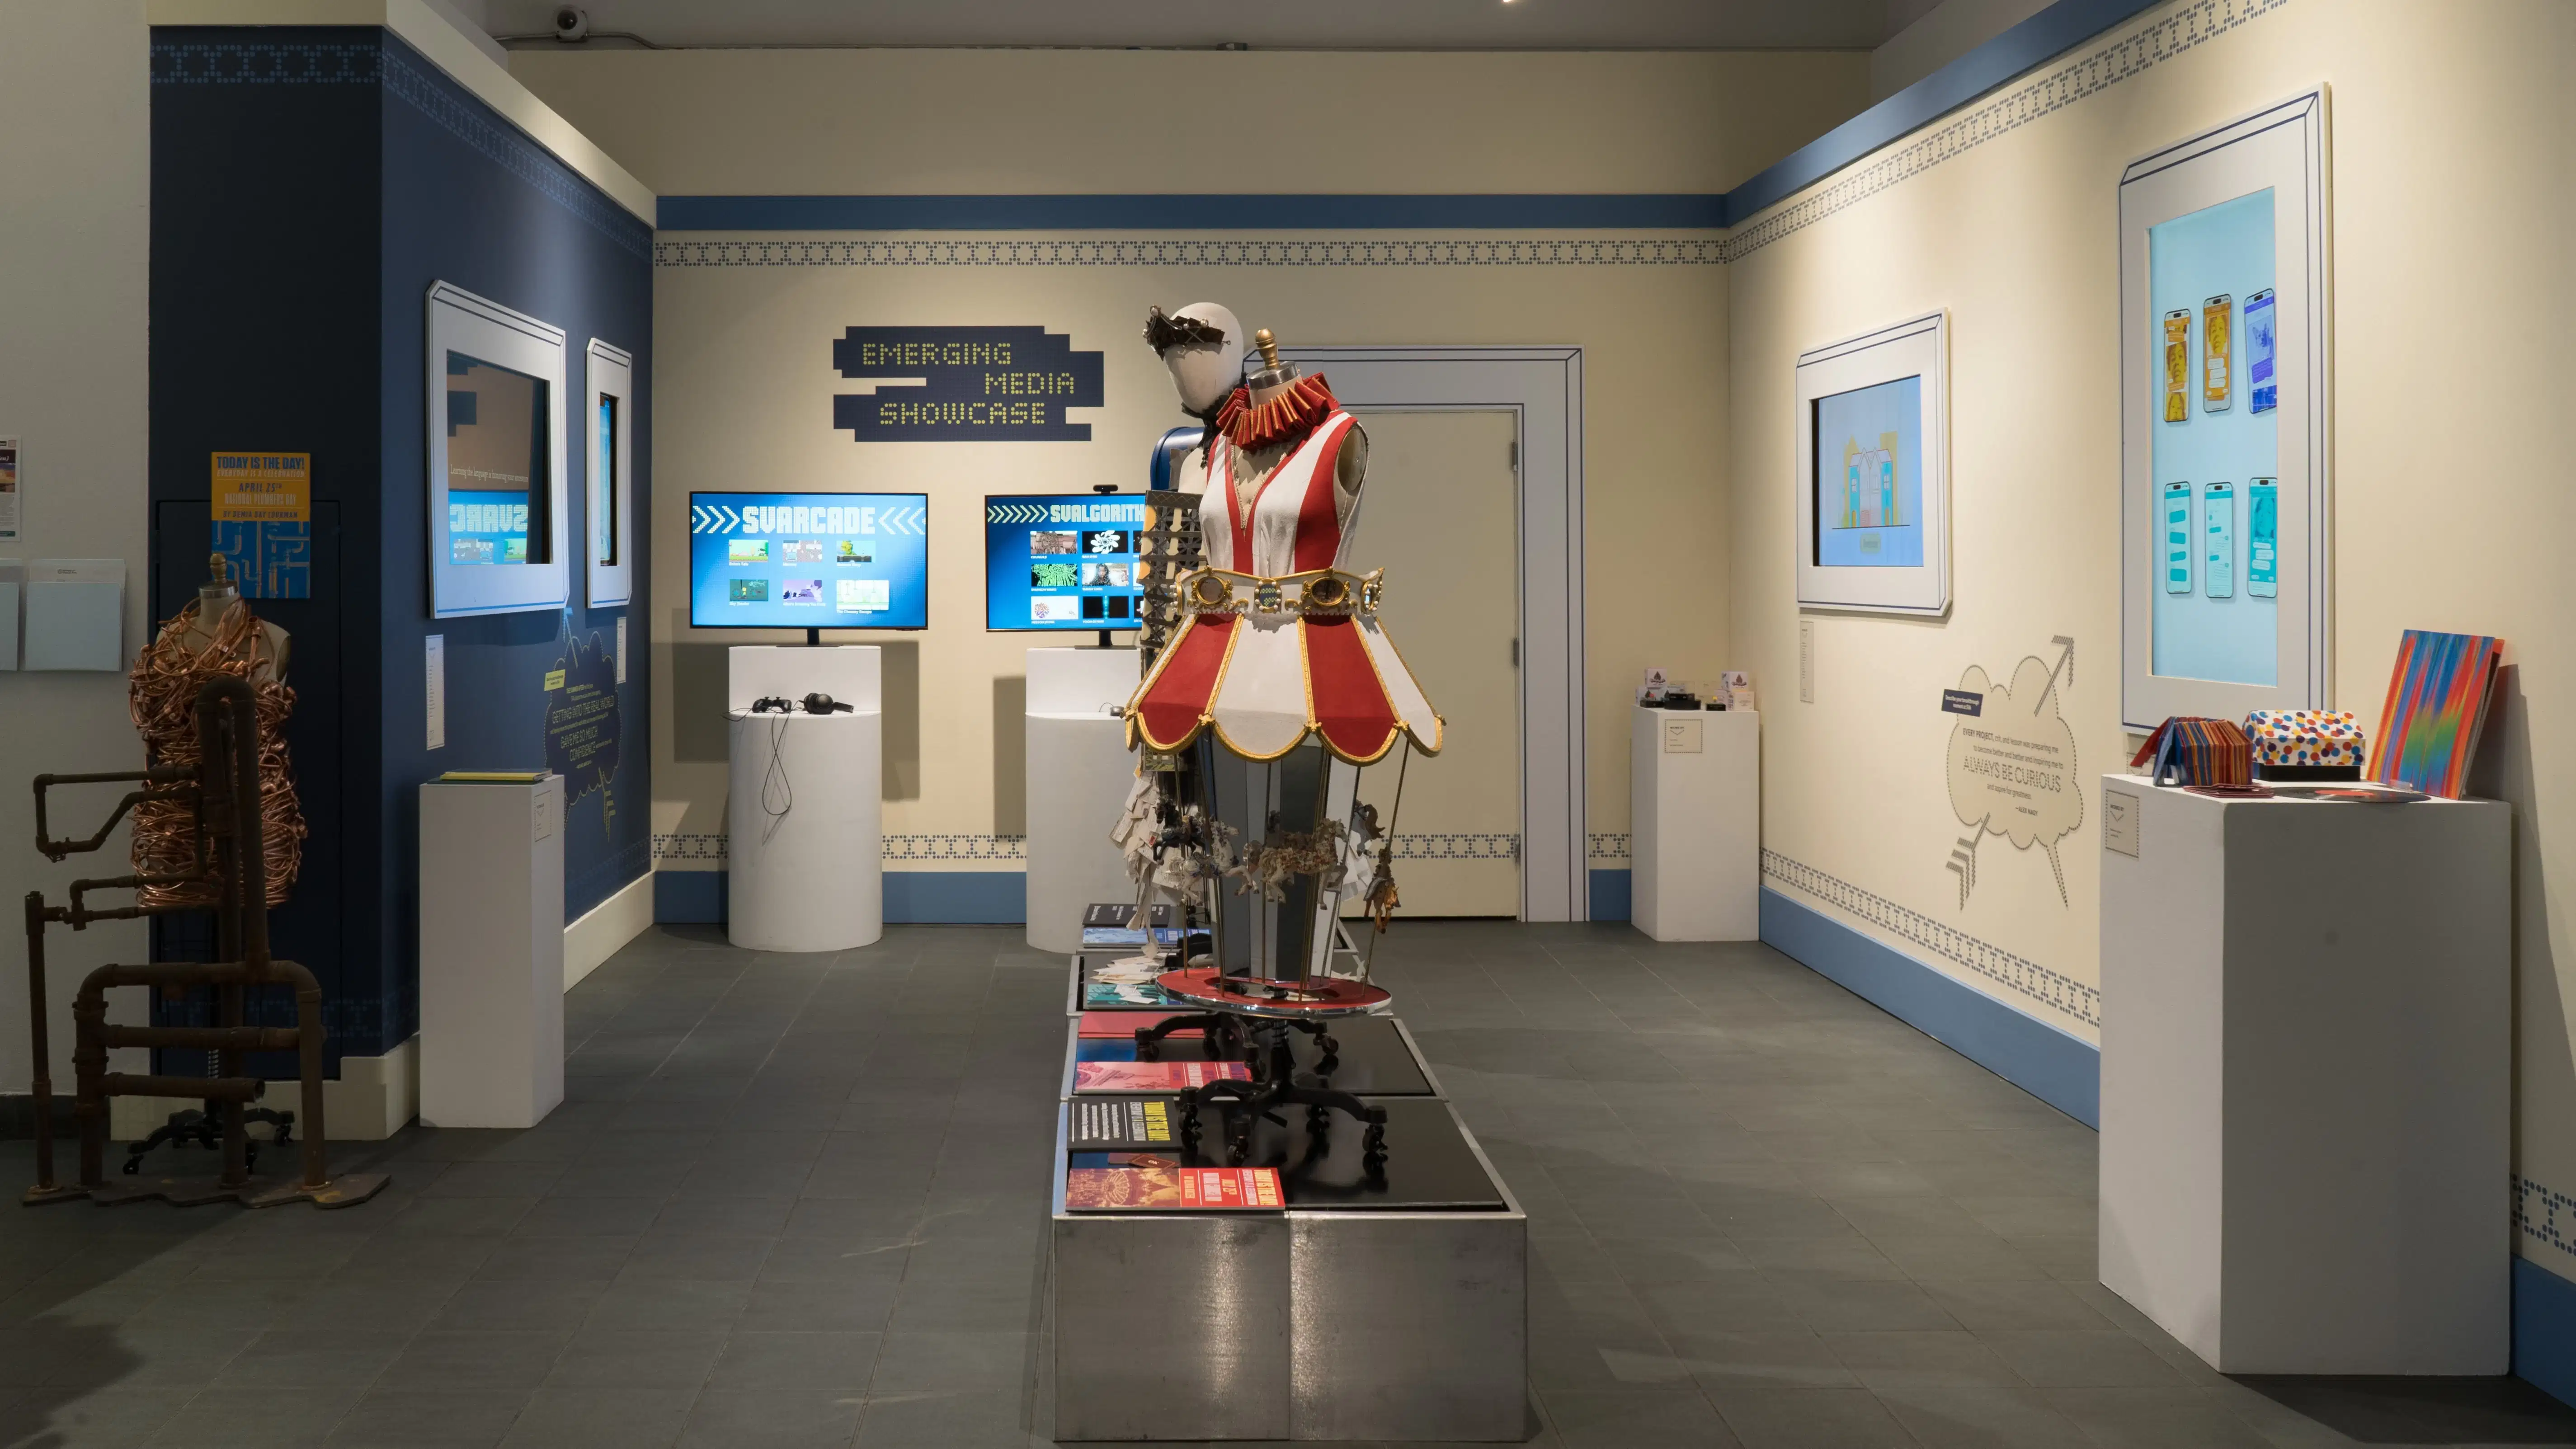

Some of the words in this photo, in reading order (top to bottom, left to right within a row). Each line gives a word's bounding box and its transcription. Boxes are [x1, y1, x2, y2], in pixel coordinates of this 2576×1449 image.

[863, 343, 1011, 365] EMERGING
[985, 373, 1074, 394] MEDIA
[880, 403, 1045, 424] SHOWCASE
[217, 456, 248, 469] TODAY
[251, 457, 260, 469] IS
[263, 457, 280, 470] THE
[283, 457, 305, 470] DAY!
[239, 483, 263, 492] APRIL
[225, 493, 252, 505] NATIONAL
[286, 494, 297, 505] DAY
[743, 506, 875, 534] SVARCADE
[1963, 728, 1975, 737] EVERY
[1976, 730, 1994, 742] PROJECT,
[2031, 743, 2051, 754] preparing
[1992, 748, 2004, 757] better
[2012, 752, 2025, 762] better
[1963, 756, 2000, 779] ALWAYS
[2002, 763, 2013, 781] BE
[2015, 767, 2061, 793] CURIOUS
[1144, 1101, 1166, 1115] TODAY
[1147, 1121, 1168, 1130] THE
[1148, 1130, 1170, 1141] DAY!
